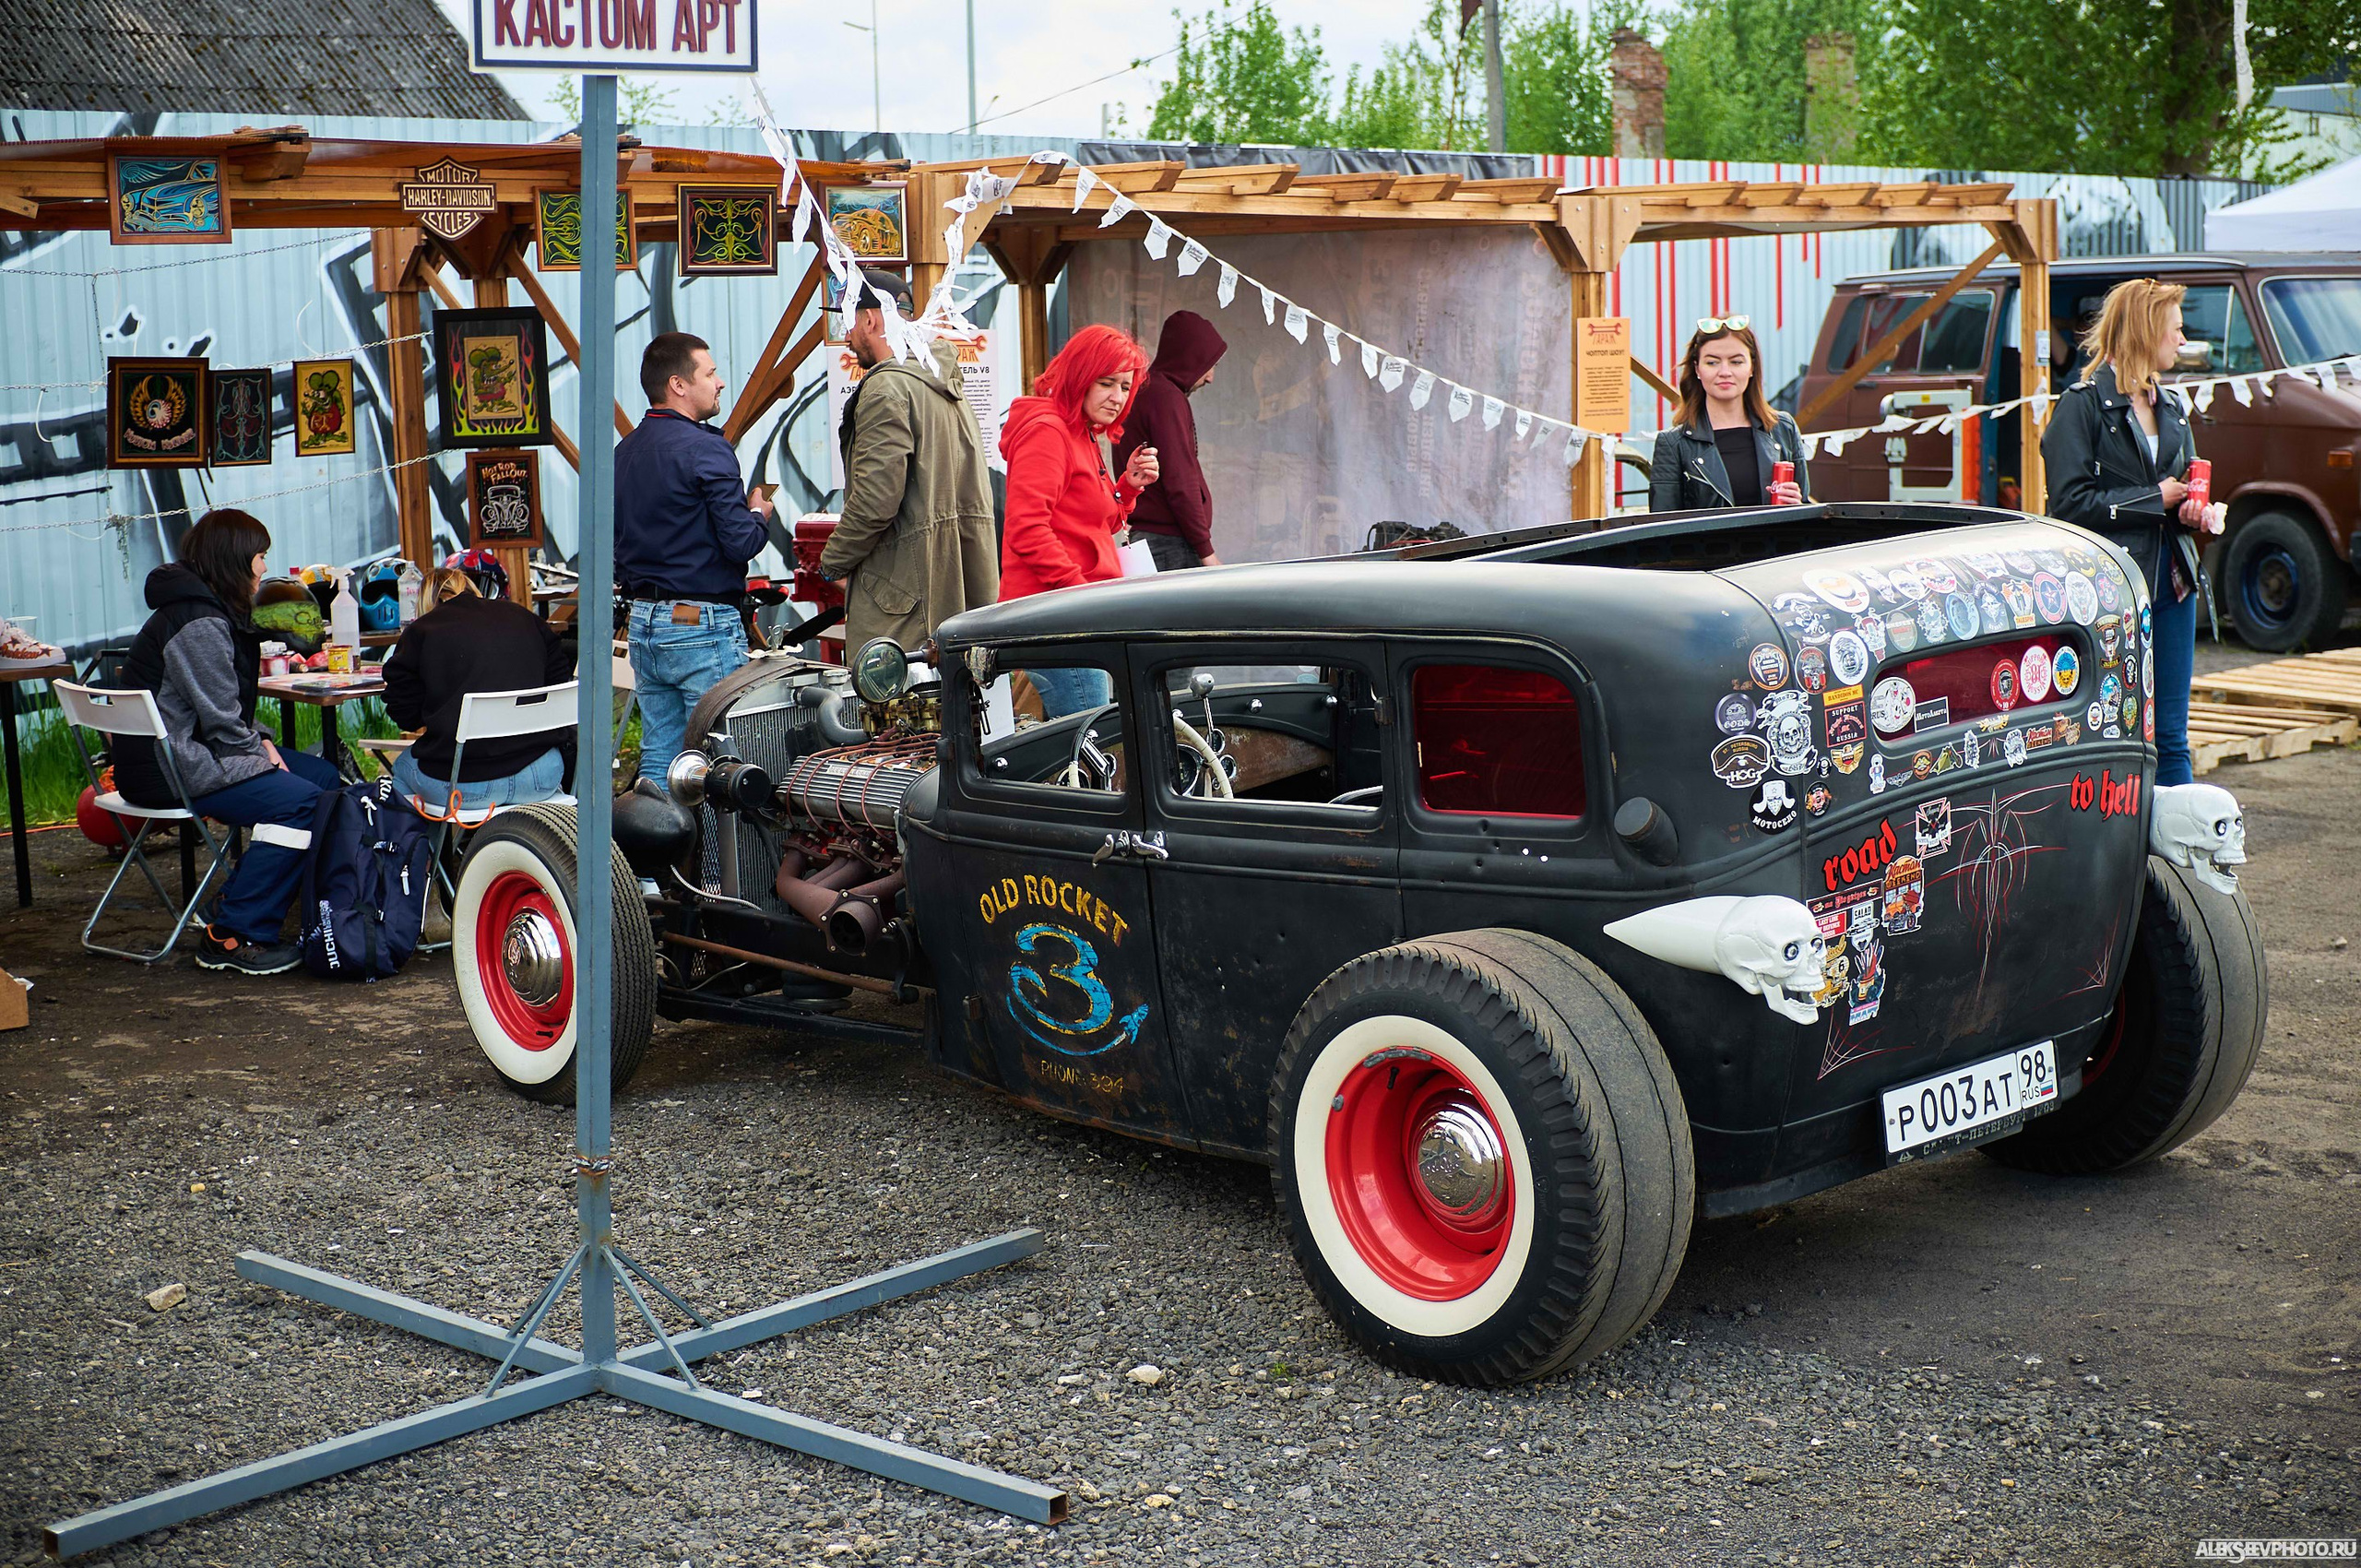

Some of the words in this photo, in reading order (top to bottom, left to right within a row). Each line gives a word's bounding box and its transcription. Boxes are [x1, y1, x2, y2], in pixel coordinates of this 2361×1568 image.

[495, 0, 658, 50] КАСТОМ
[672, 0, 740, 54] АРТ
[427, 164, 470, 183] MOTOR
[408, 188, 491, 206] HARLEY-DAVIDSON
[428, 211, 471, 234] CYCLES
[957, 348, 980, 363] РАЖ
[979, 366, 991, 374] V8
[1832, 704, 1858, 717] SUPPORT
[1836, 731, 1858, 742] RUSSIA
[1730, 767, 1756, 782] HOG
[1752, 810, 1797, 829] МОТОСЕЛО
[1822, 816, 1899, 892] road
[2070, 771, 2095, 812] to
[2099, 768, 2142, 820] hell
[979, 877, 1019, 924] OLD
[1024, 874, 1130, 947] ROCKET
[2020, 1050, 2047, 1088] 98
[2022, 1085, 2040, 1102] RUS
[1898, 1072, 2013, 1142] Р003АТ
[1923, 1109, 2029, 1156] САТ-ПЕТЕРБУРГ
